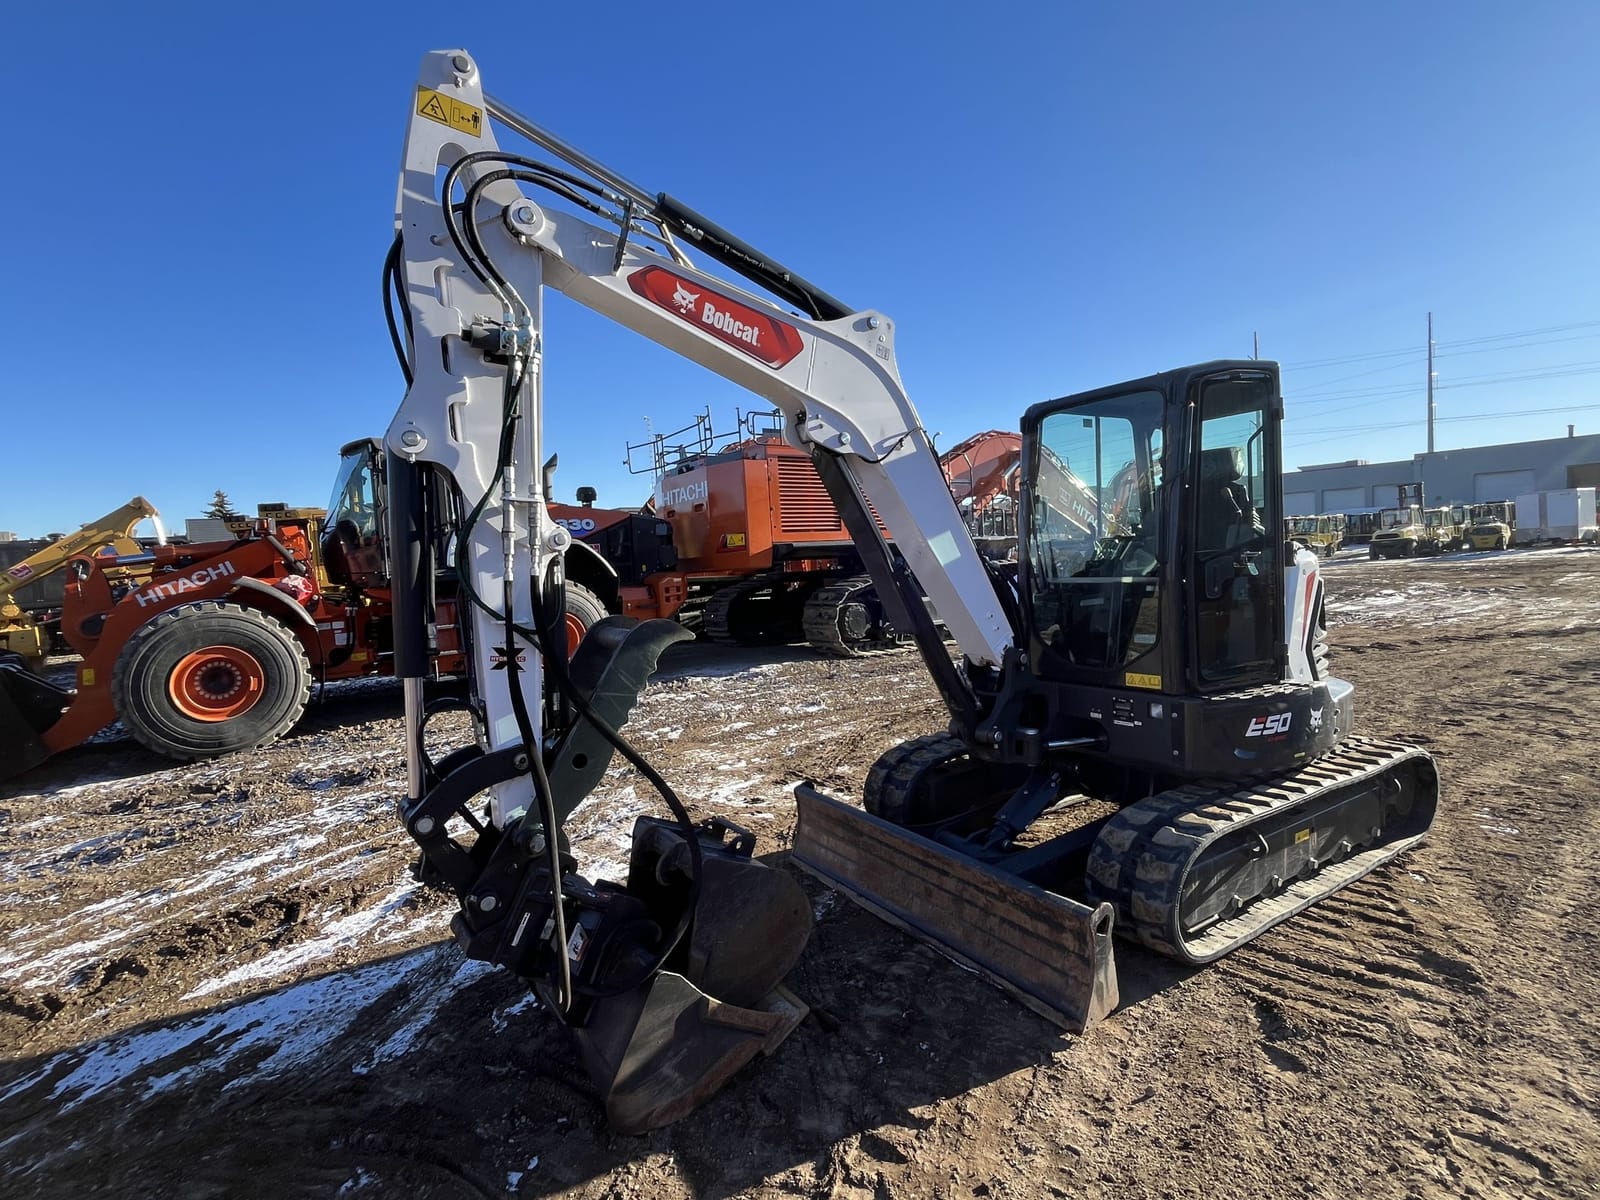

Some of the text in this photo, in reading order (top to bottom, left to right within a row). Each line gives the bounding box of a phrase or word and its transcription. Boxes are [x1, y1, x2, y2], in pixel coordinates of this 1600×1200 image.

[702, 302, 760, 346] Bobcat
[662, 481, 708, 505] HITACHI
[135, 561, 235, 607] HITACHI
[1245, 711, 1292, 737] E50
